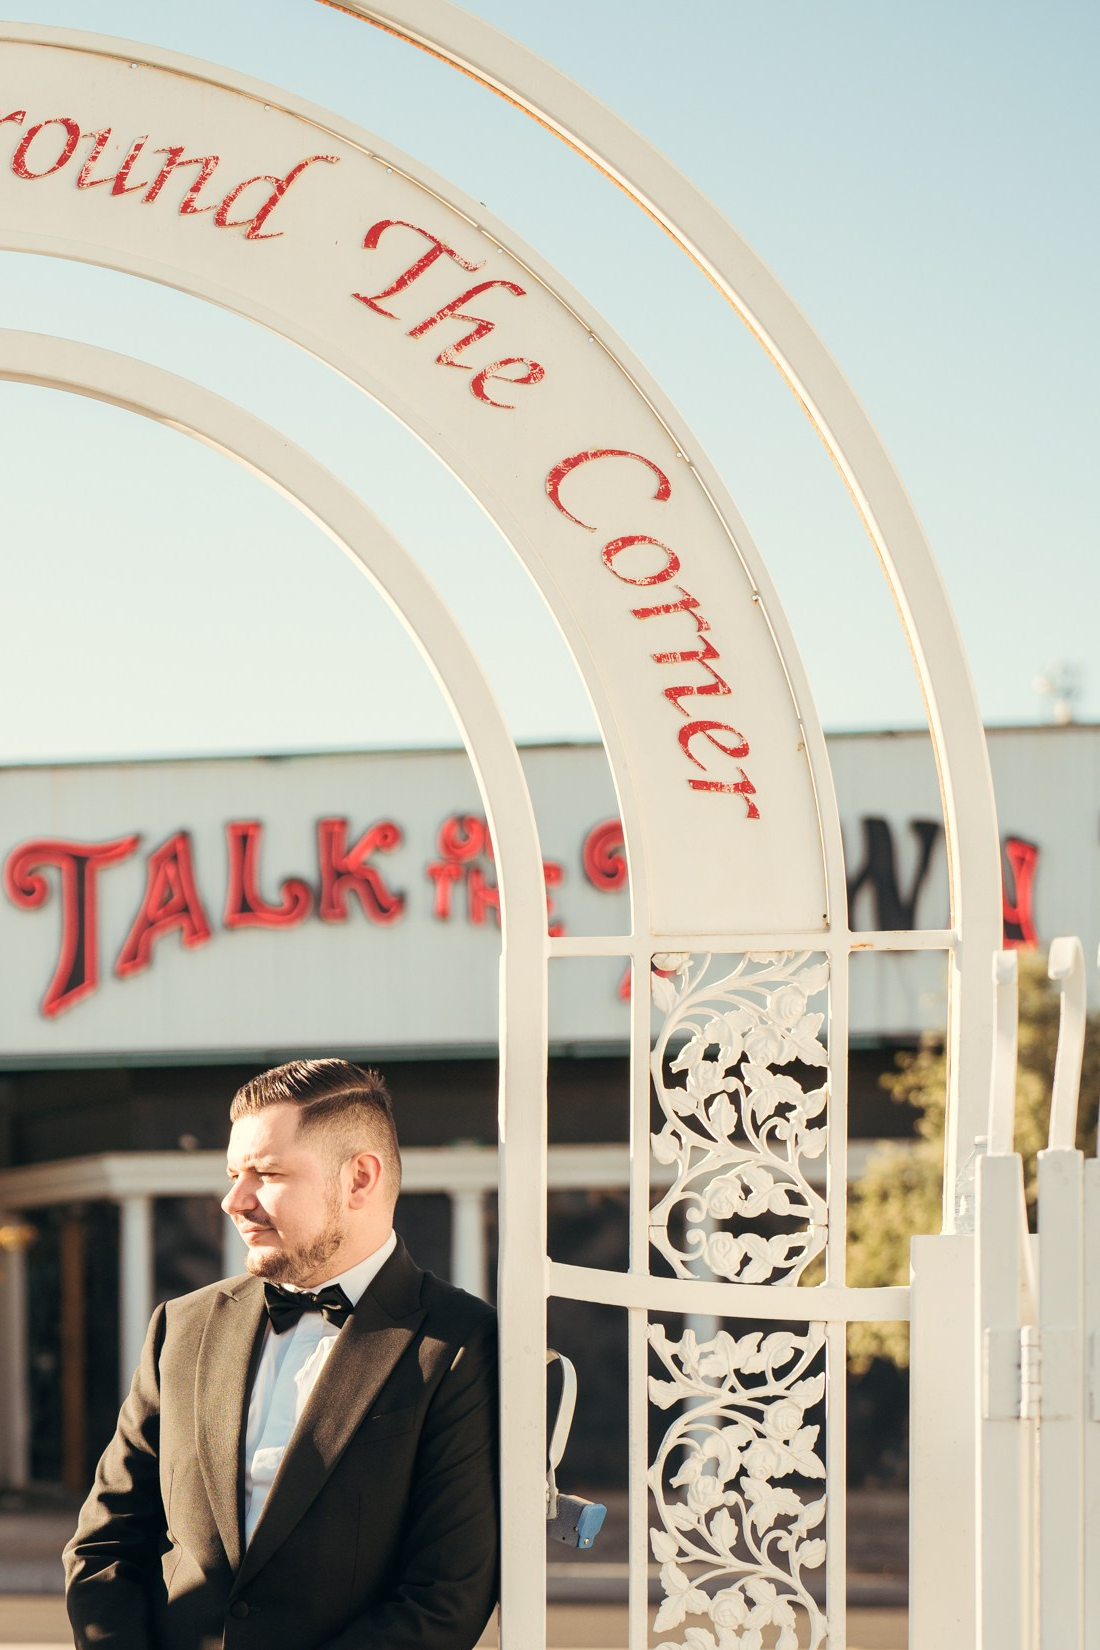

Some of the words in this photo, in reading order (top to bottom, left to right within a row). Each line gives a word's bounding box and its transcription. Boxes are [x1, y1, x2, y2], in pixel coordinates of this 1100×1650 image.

[350, 218, 545, 409] The
[545, 448, 761, 820] Corner
[3, 816, 407, 1018] TALK
